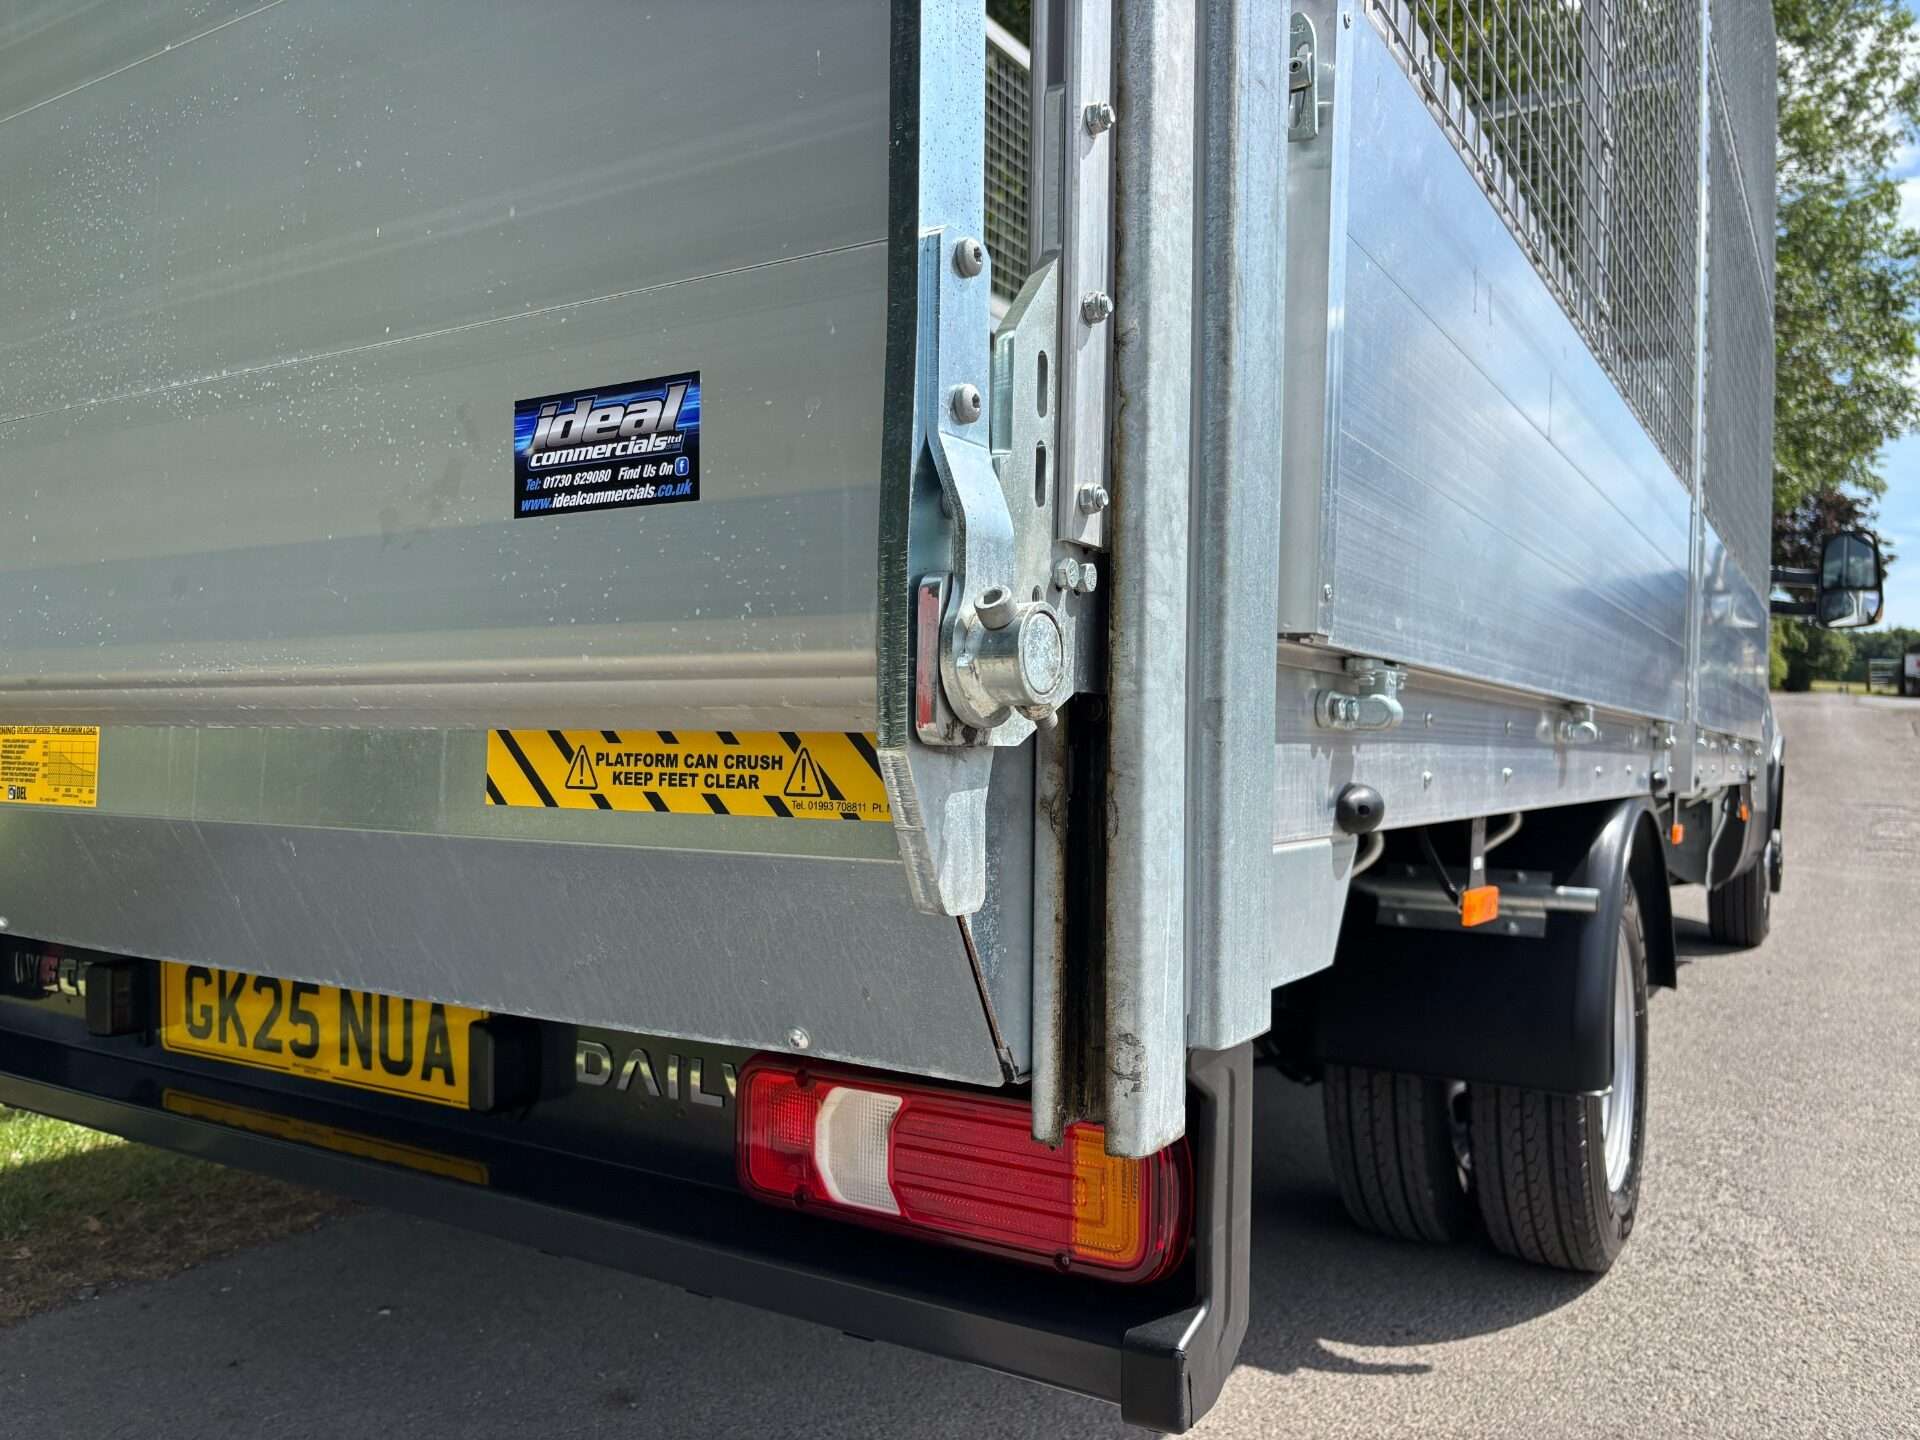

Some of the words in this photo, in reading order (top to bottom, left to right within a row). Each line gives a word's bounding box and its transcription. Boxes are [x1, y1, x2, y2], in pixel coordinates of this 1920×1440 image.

[528, 381, 691, 451] ideal
[530, 433, 668, 467] commercials
[526, 477, 541, 491] Tel:
[543, 474, 571, 488] 01730
[574, 469, 611, 486] 829080
[618, 466, 640, 481] Find
[643, 464, 655, 478] Us
[659, 462, 673, 476] On
[521, 479, 692, 511] www.idealcommercials.co.uk
[595, 752, 679, 769] PLATFORM
[684, 753, 719, 770] CAN
[724, 754, 783, 771] CRUSH
[612, 772, 653, 787] KEEP
[659, 772, 698, 788] FEET
[704, 773, 760, 790] CLEAR
[808, 801, 834, 811] 01993
[836, 801, 866, 812] 708811
[184, 965, 320, 1061] GK25
[339, 989, 456, 1087] NUA
